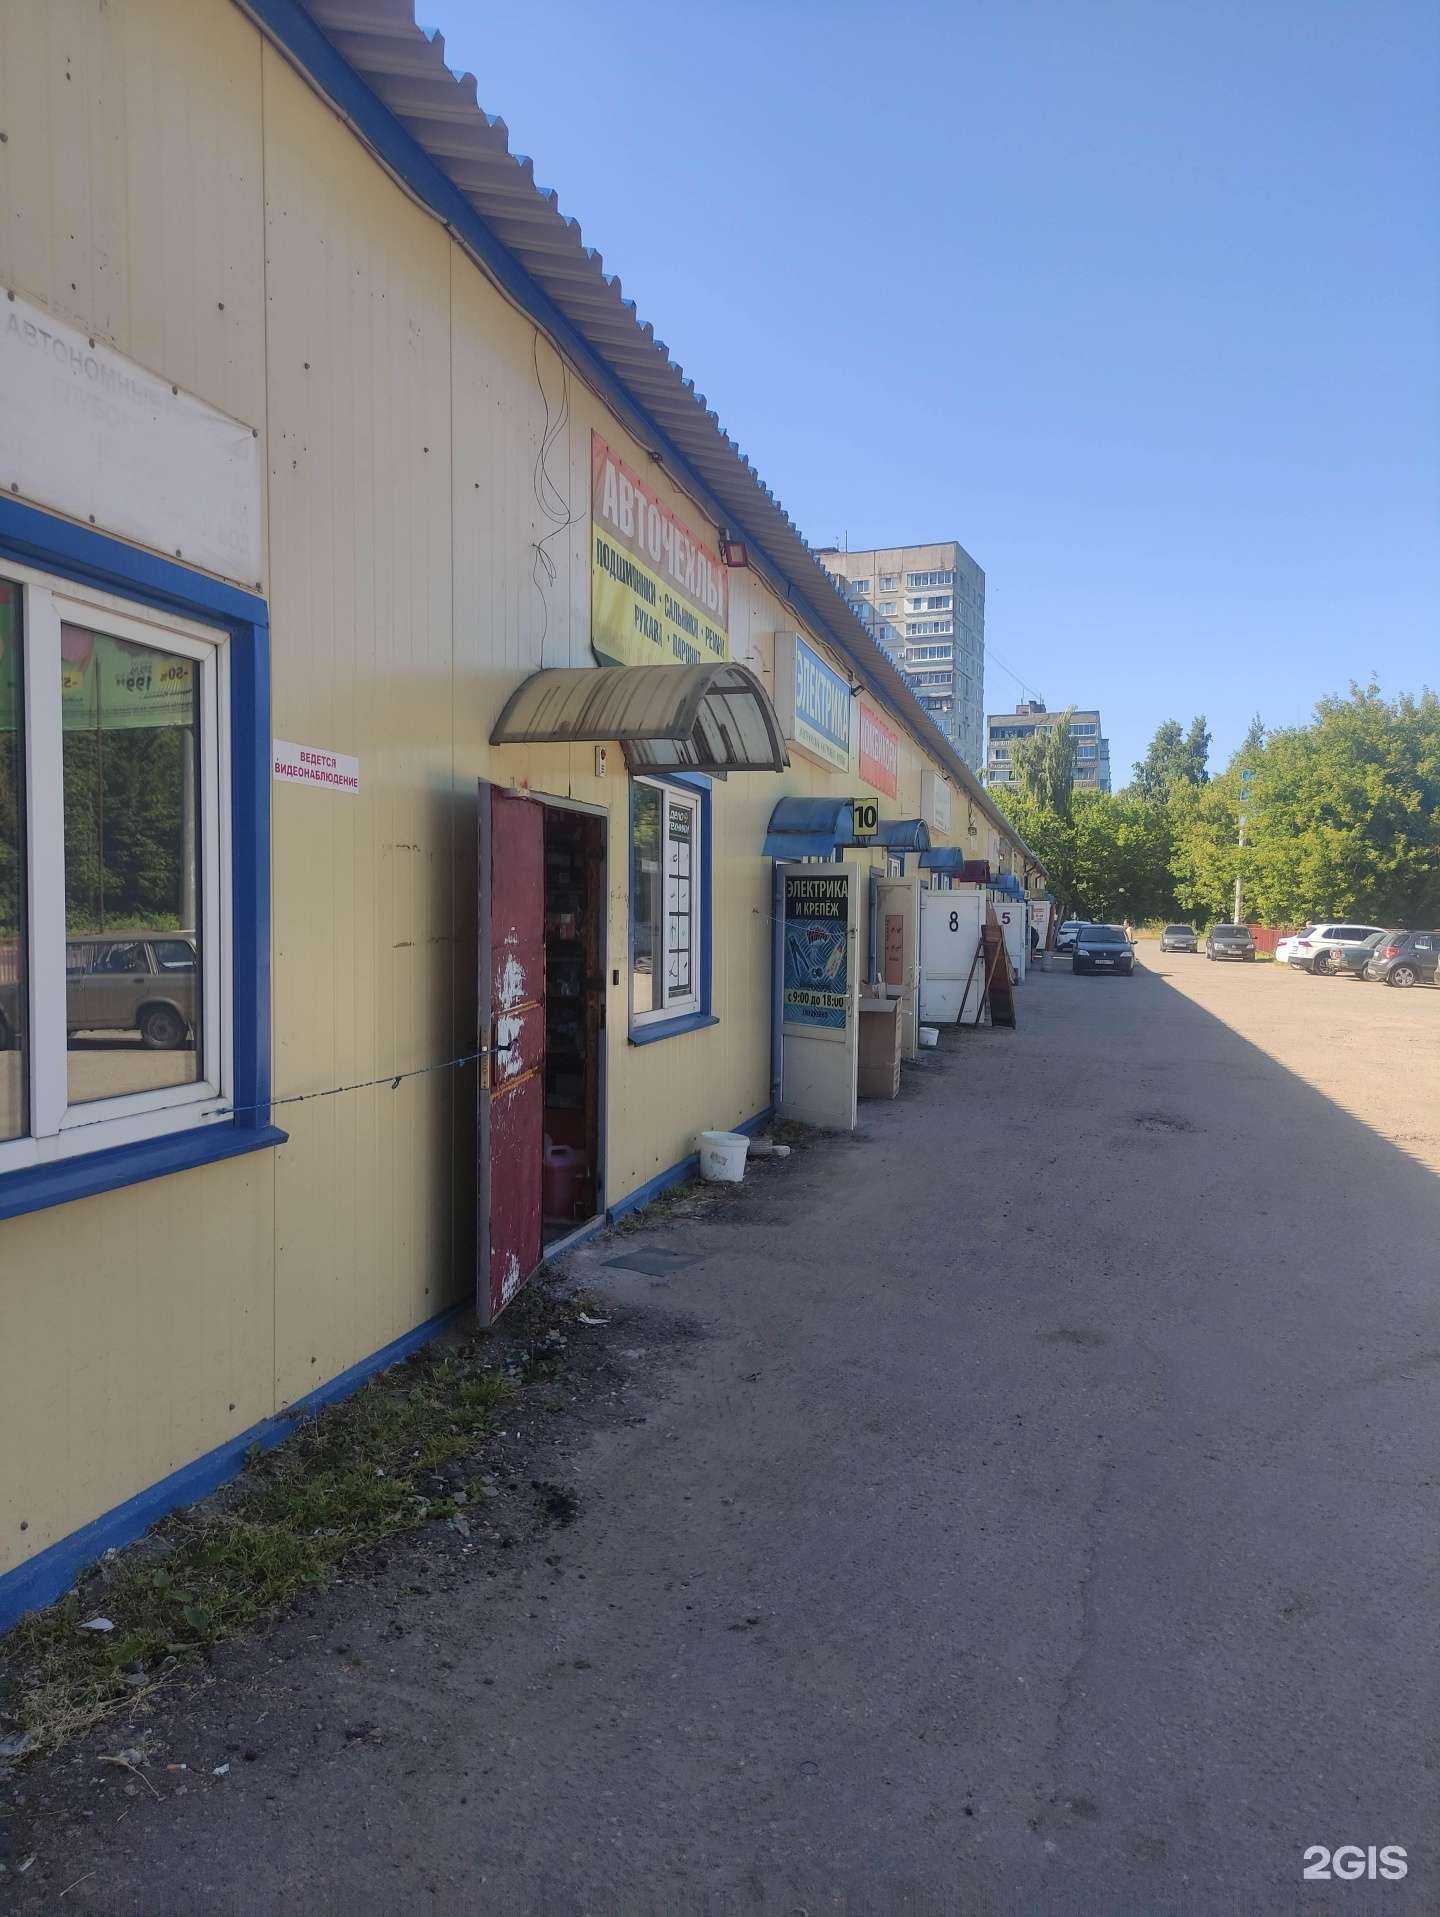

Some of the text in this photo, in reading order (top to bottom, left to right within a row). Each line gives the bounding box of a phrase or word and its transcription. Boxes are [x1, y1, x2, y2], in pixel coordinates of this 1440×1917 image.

[602, 455, 724, 617] АВТОЧЕХЛЫ
[596, 537, 656, 607] ПОДШИПНИКИ
[664, 593, 699, 640] САЛЬНИКИ
[634, 604, 663, 648] РУКАВА
[796, 651, 849, 744] ЭЛЕКТРИКА
[300, 752, 337, 768] ВЕДЕТСЯ
[274, 762, 358, 787] ВИДЕОНАБЛЮДЕНИЕ
[854, 805, 877, 828] 10
[787, 880, 848, 898] ЭЛЕКТРИКА
[796, 901, 839, 917] И КРЕПЁЖ
[1001, 912, 1011, 925] 5
[949, 911, 959, 932] 8
[793, 991, 809, 1003] 9:00
[811, 995, 821, 1006] до
[823, 994, 844, 1007] 18:00
